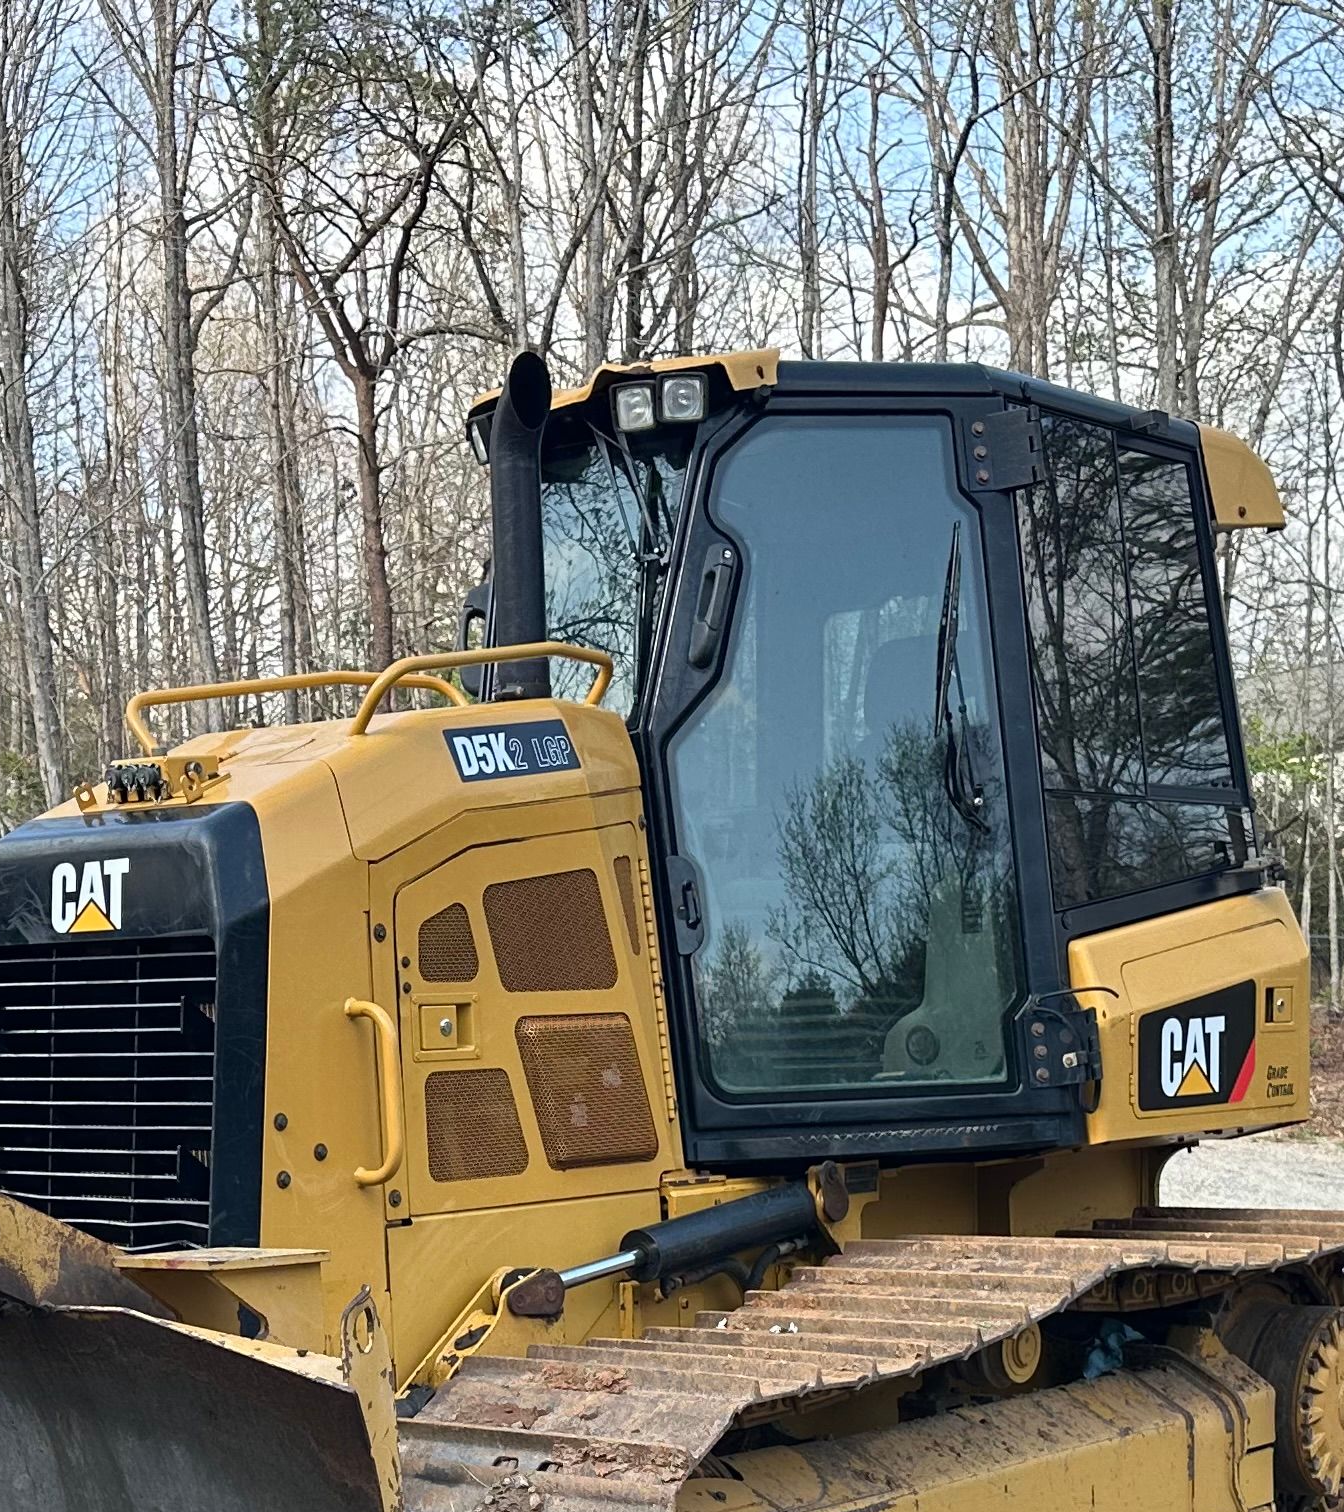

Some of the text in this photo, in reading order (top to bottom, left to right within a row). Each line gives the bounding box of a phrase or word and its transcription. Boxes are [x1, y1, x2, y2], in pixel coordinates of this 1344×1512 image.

[531, 735, 571, 768] LGP
[51, 857, 130, 934] CAT
[1160, 1015, 1226, 1098] CAT
